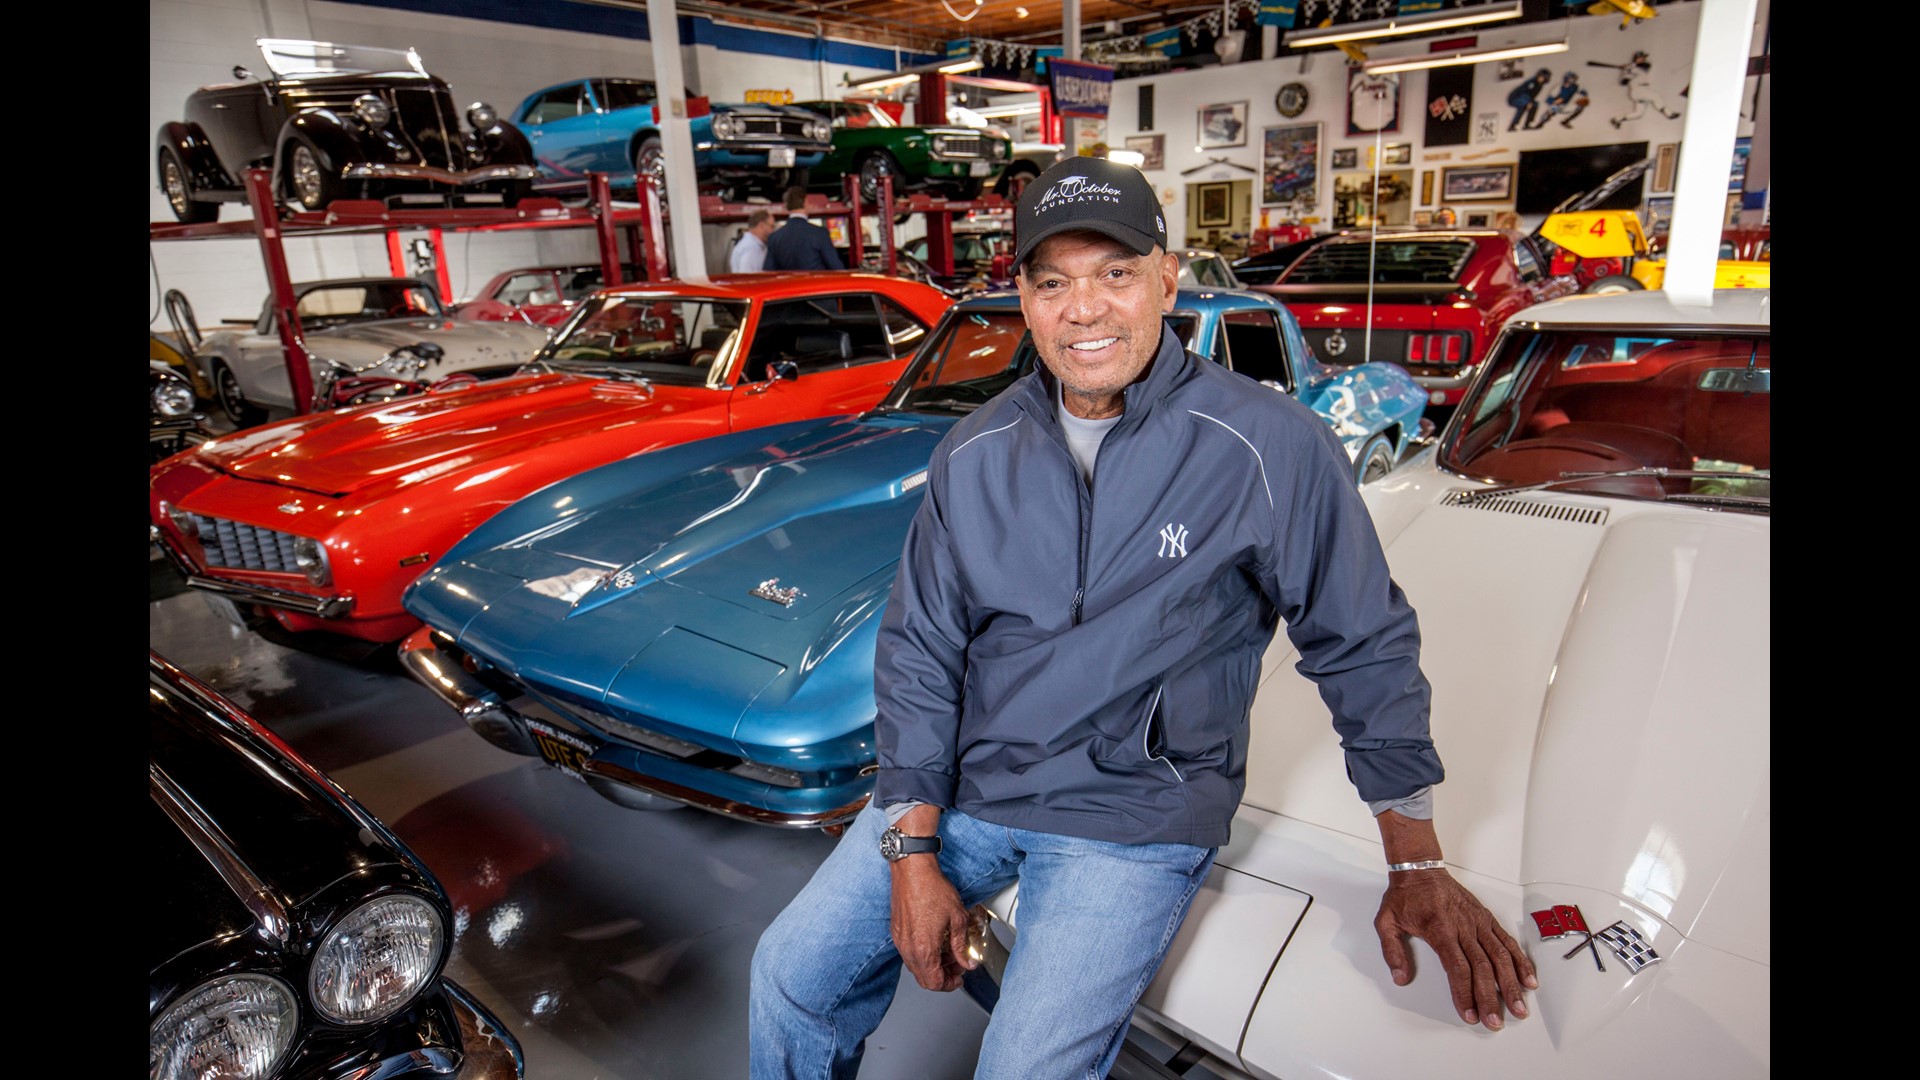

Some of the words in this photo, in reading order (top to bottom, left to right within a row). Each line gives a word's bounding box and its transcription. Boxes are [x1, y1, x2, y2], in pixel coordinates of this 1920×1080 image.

[1034, 186, 1061, 210] Mr.
[1035, 195, 1119, 217] FOUNDATION
[1589, 218, 1606, 238] 4
[1157, 522, 1189, 558] NY
[537, 735, 580, 772] UTE
